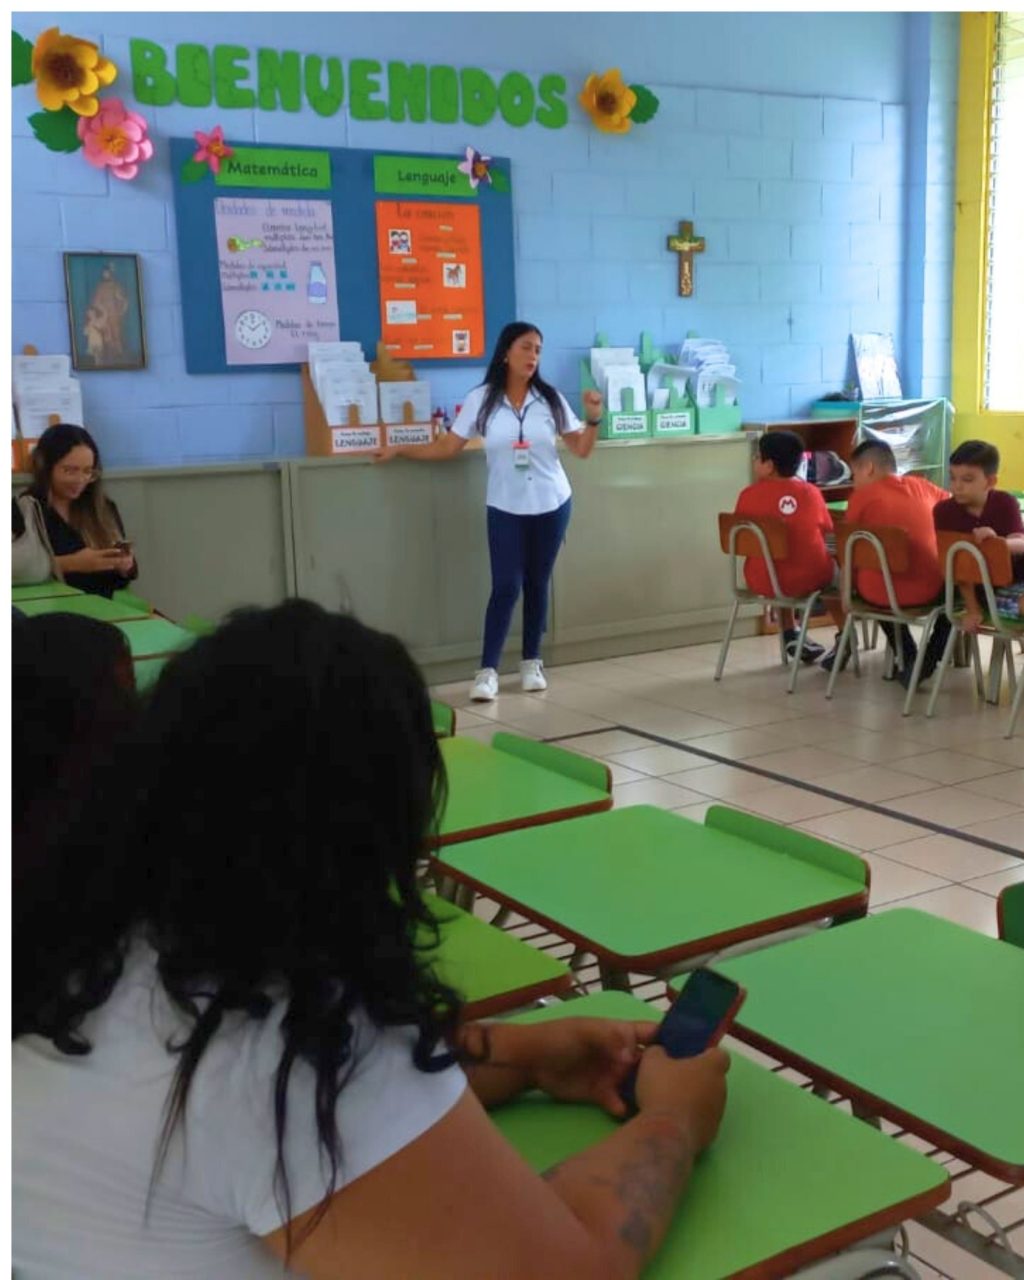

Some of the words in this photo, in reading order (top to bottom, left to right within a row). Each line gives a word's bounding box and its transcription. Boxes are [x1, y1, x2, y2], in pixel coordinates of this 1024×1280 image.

[129, 38, 569, 129] BIENVENIDOS
[227, 160, 318, 178] Matemática
[397, 169, 456, 187] Lenguaje
